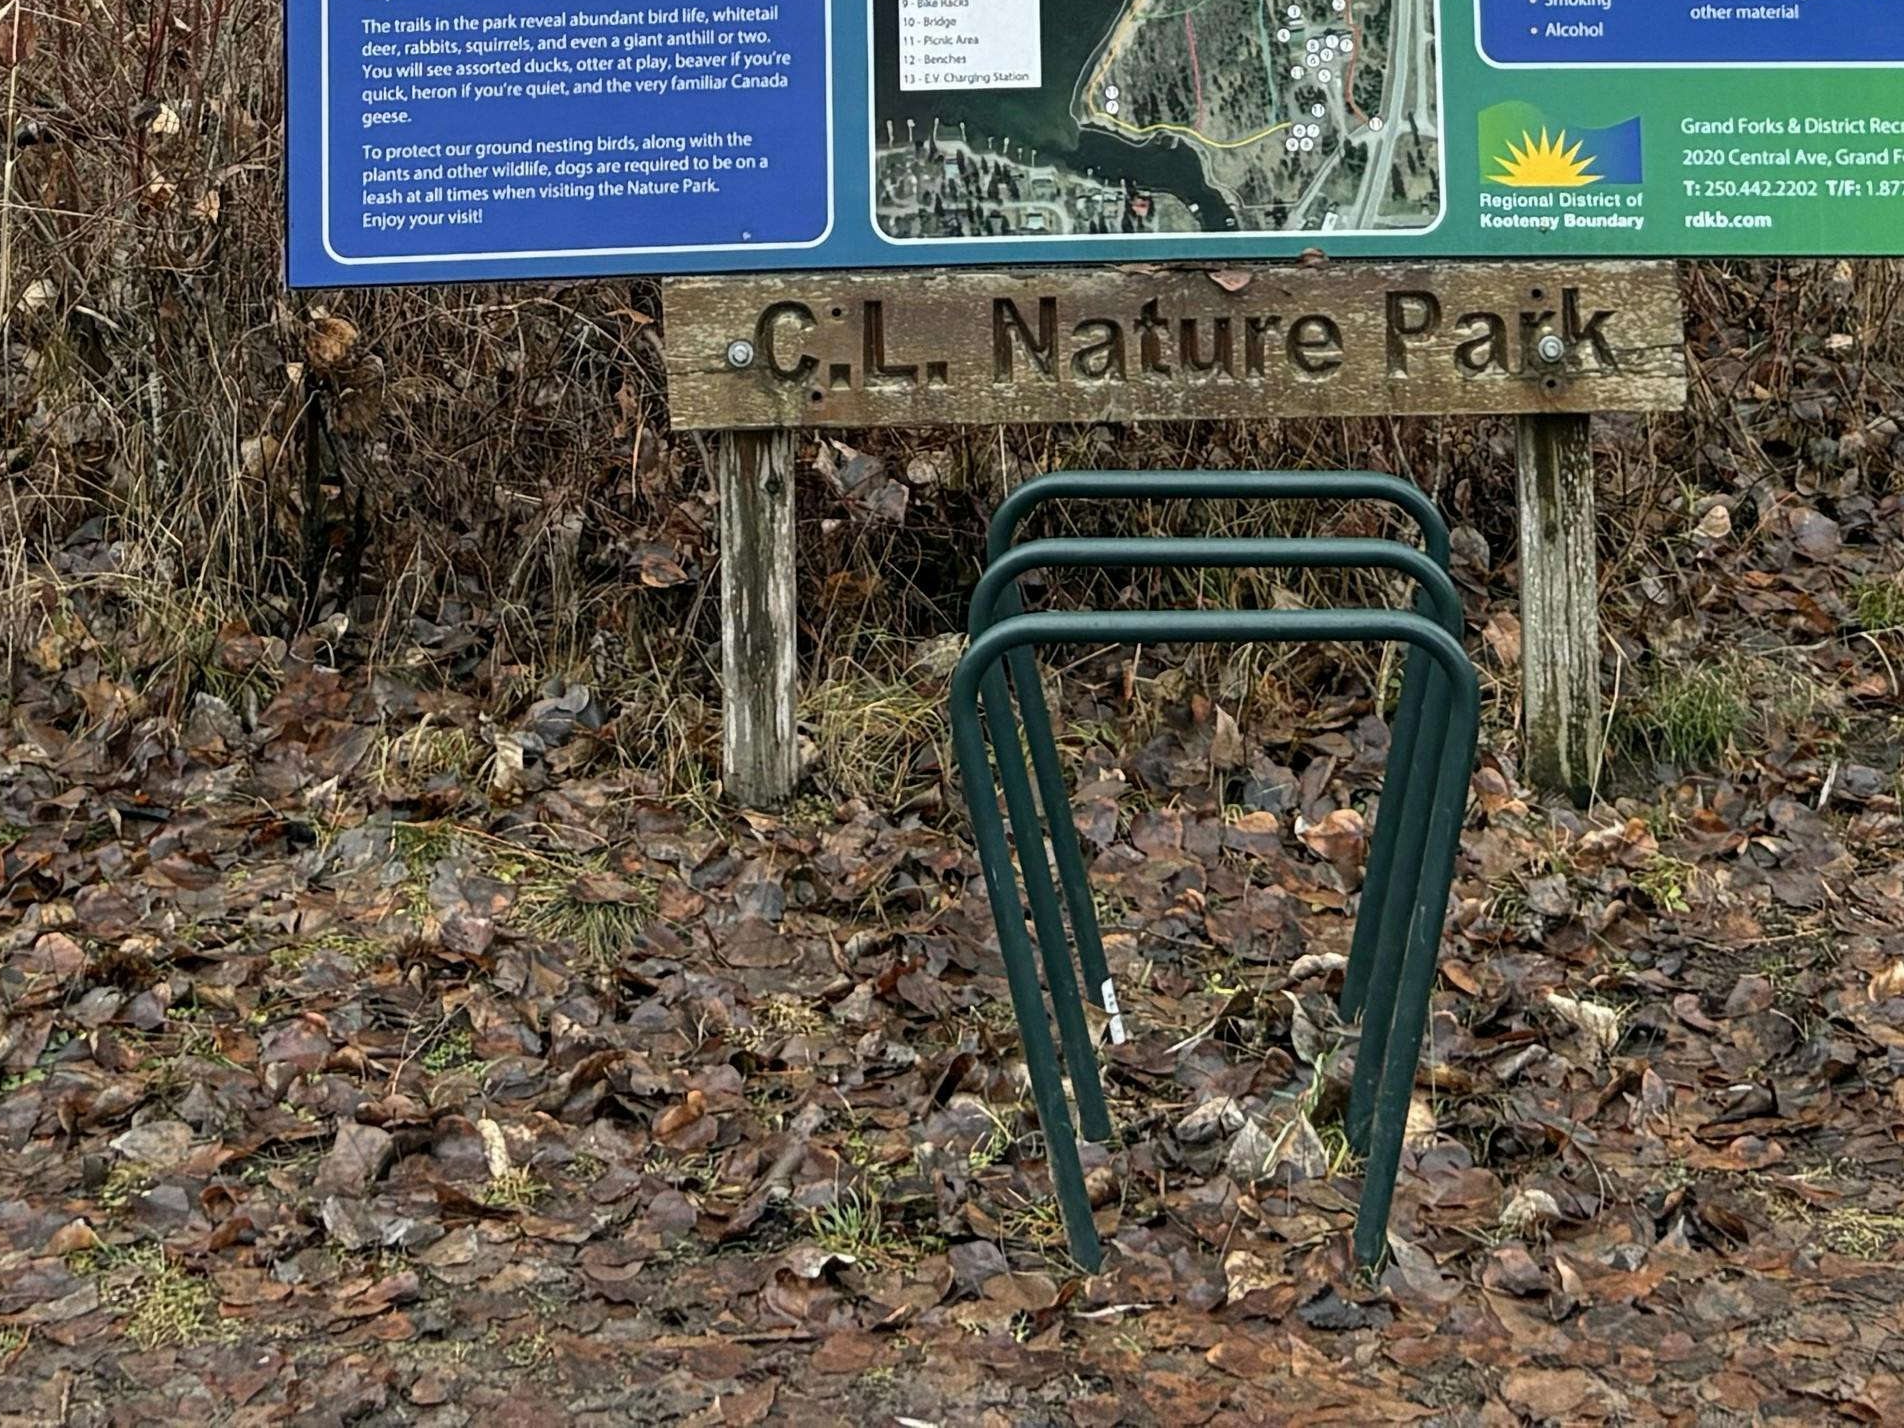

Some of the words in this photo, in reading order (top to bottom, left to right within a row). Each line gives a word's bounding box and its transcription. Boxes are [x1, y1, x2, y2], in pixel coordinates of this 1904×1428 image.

[1690, 4, 1732, 19] other
[1736, 4, 1799, 19] material
[923, 16, 957, 29] Bridge
[1545, 22, 1603, 37] Alcohol
[923, 35, 953, 46] Picnic
[956, 35, 979, 45] Area
[924, 54, 966, 64] Benches
[362, 112, 412, 128] geese.
[1681, 118, 1734, 134] Grand
[1738, 118, 1784, 134] Forks
[1787, 118, 1801, 134] &
[1805, 117, 1866, 134] District
[1683, 149, 1725, 165] 2020
[1728, 148, 1790, 166] Central
[1794, 149, 1832, 167] Ave,
[1835, 148, 1889, 165] Grand
[1683, 180, 1700, 196] T:
[1705, 180, 1818, 196] 250.442.2202
[1825, 180, 1861, 196] T/F:
[1480, 192, 1553, 210] Regional
[1559, 192, 1621, 207] District
[1626, 192, 1643, 207] of
[363, 212, 406, 230] Enjoy
[409, 213, 444, 230] your
[448, 208, 482, 224] visit!
[1480, 213, 1559, 230] Kootenay
[1564, 213, 1644, 230] Boundary
[1685, 211, 1772, 228] rdkb.com
[753, 300, 948, 390] C.L.
[992, 295, 1344, 386] Nature
[1385, 287, 1619, 381] Park
